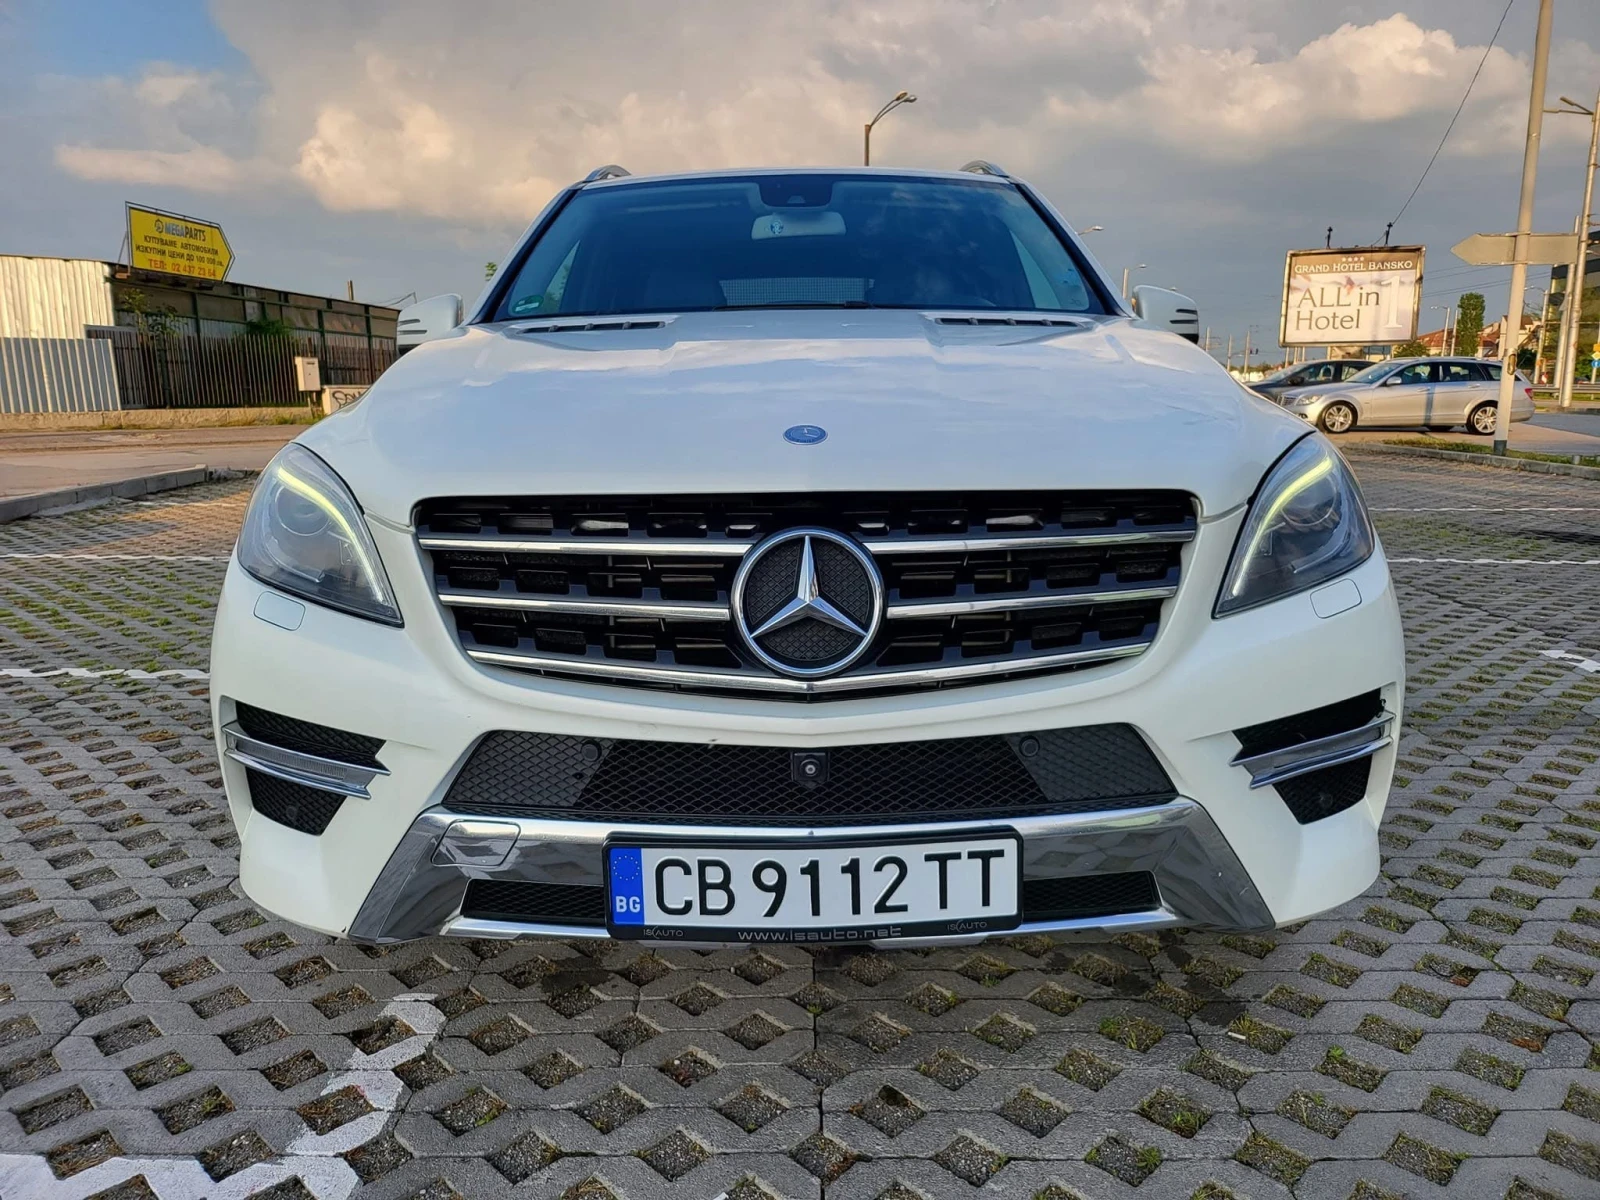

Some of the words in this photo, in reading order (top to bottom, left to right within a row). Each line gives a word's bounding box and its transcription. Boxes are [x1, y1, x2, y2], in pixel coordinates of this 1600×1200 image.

[165, 222, 206, 241] MEGAPARTS
[136, 244, 166, 256] ИЗКУПНИ
[168, 249, 184, 259] ЦЕНИ
[144, 235, 177, 248] КУПУВАМЕ
[181, 242, 218, 255] АВТОМОБИЛИ
[148, 258, 167, 270] ТЕЛ:
[1295, 264, 1329, 273] GRAND
[1333, 262, 1366, 272] HOTEL
[1368, 260, 1413, 270] BANSKO
[1297, 286, 1351, 308] ALL
[1359, 286, 1380, 306] in
[1295, 309, 1361, 330] Hotel
[655, 858, 736, 916] CB
[752, 856, 908, 917] 9112
[924, 849, 1005, 910] TT
[615, 895, 641, 913] BG
[738, 926, 902, 941] www.isauto.net
